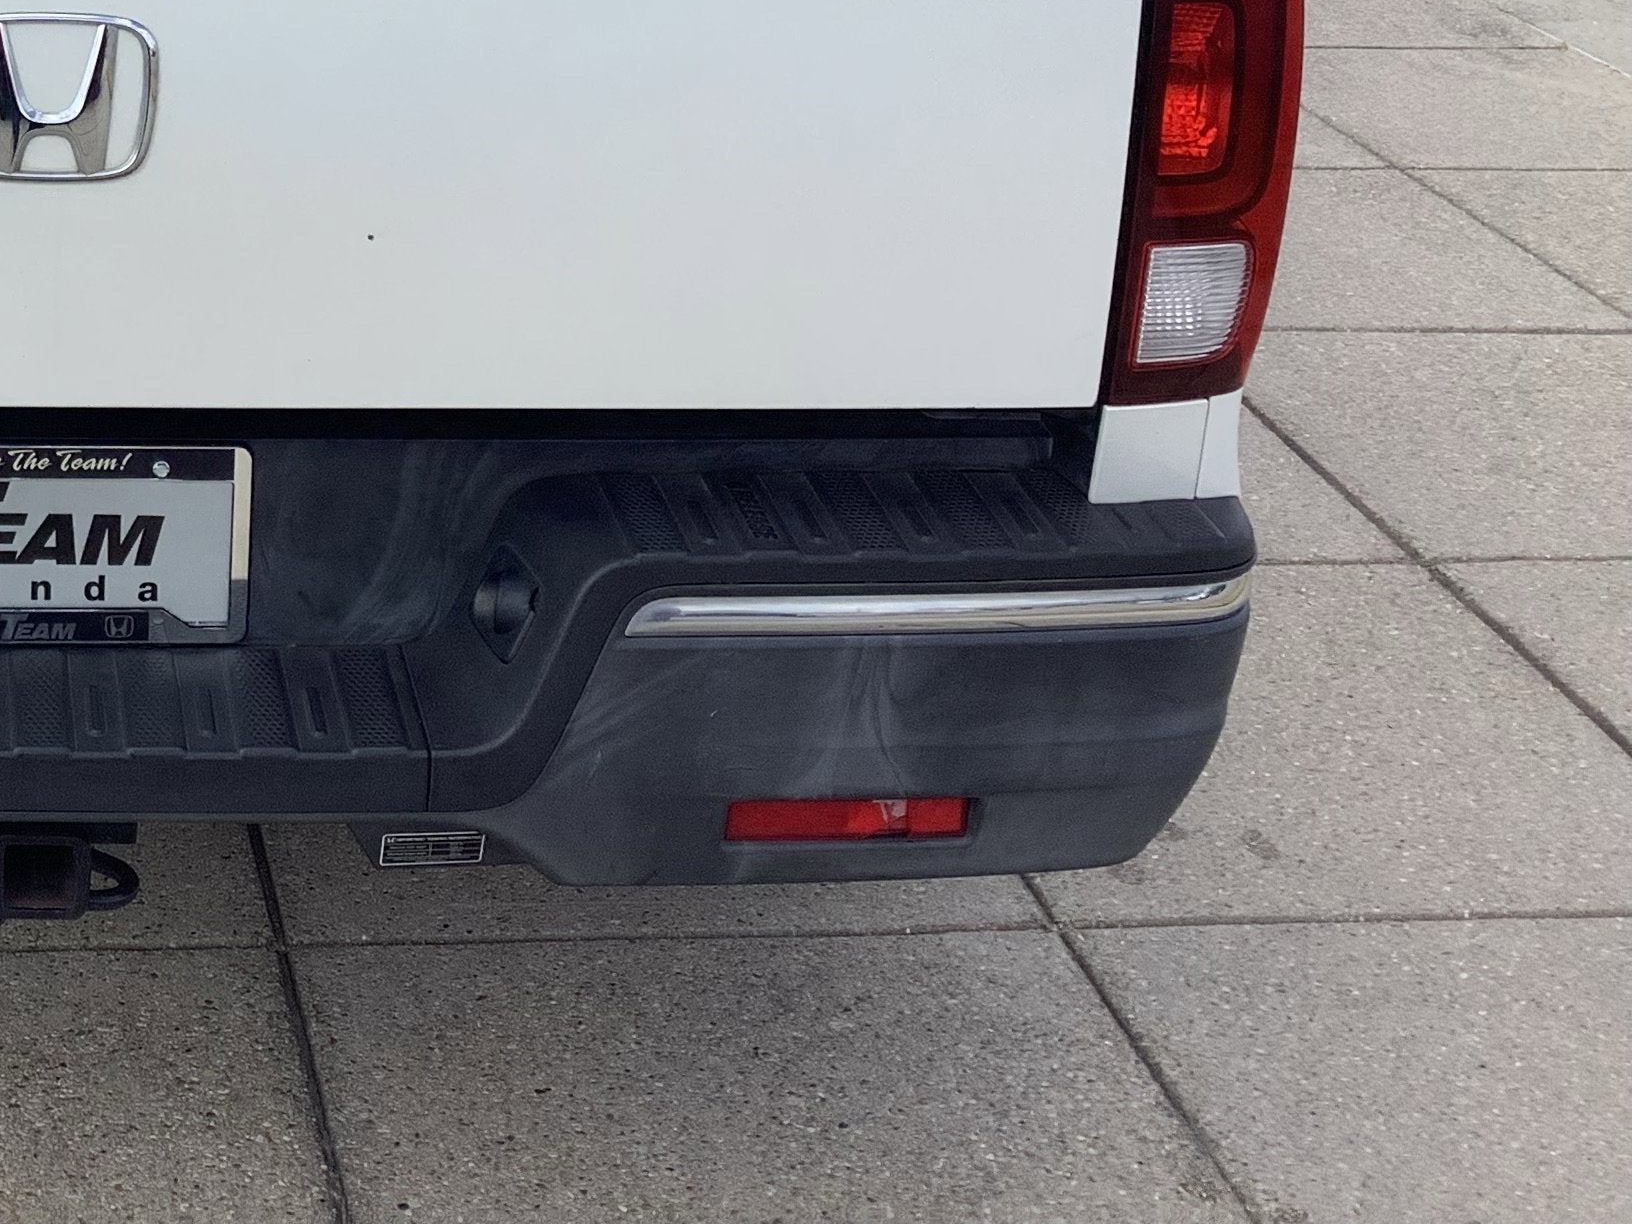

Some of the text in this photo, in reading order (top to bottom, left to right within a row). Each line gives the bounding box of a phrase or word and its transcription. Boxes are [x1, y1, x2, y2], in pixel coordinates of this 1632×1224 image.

[7, 449, 52, 472] The
[55, 450, 133, 472] Team!
[0, 612, 77, 641] TEAM
